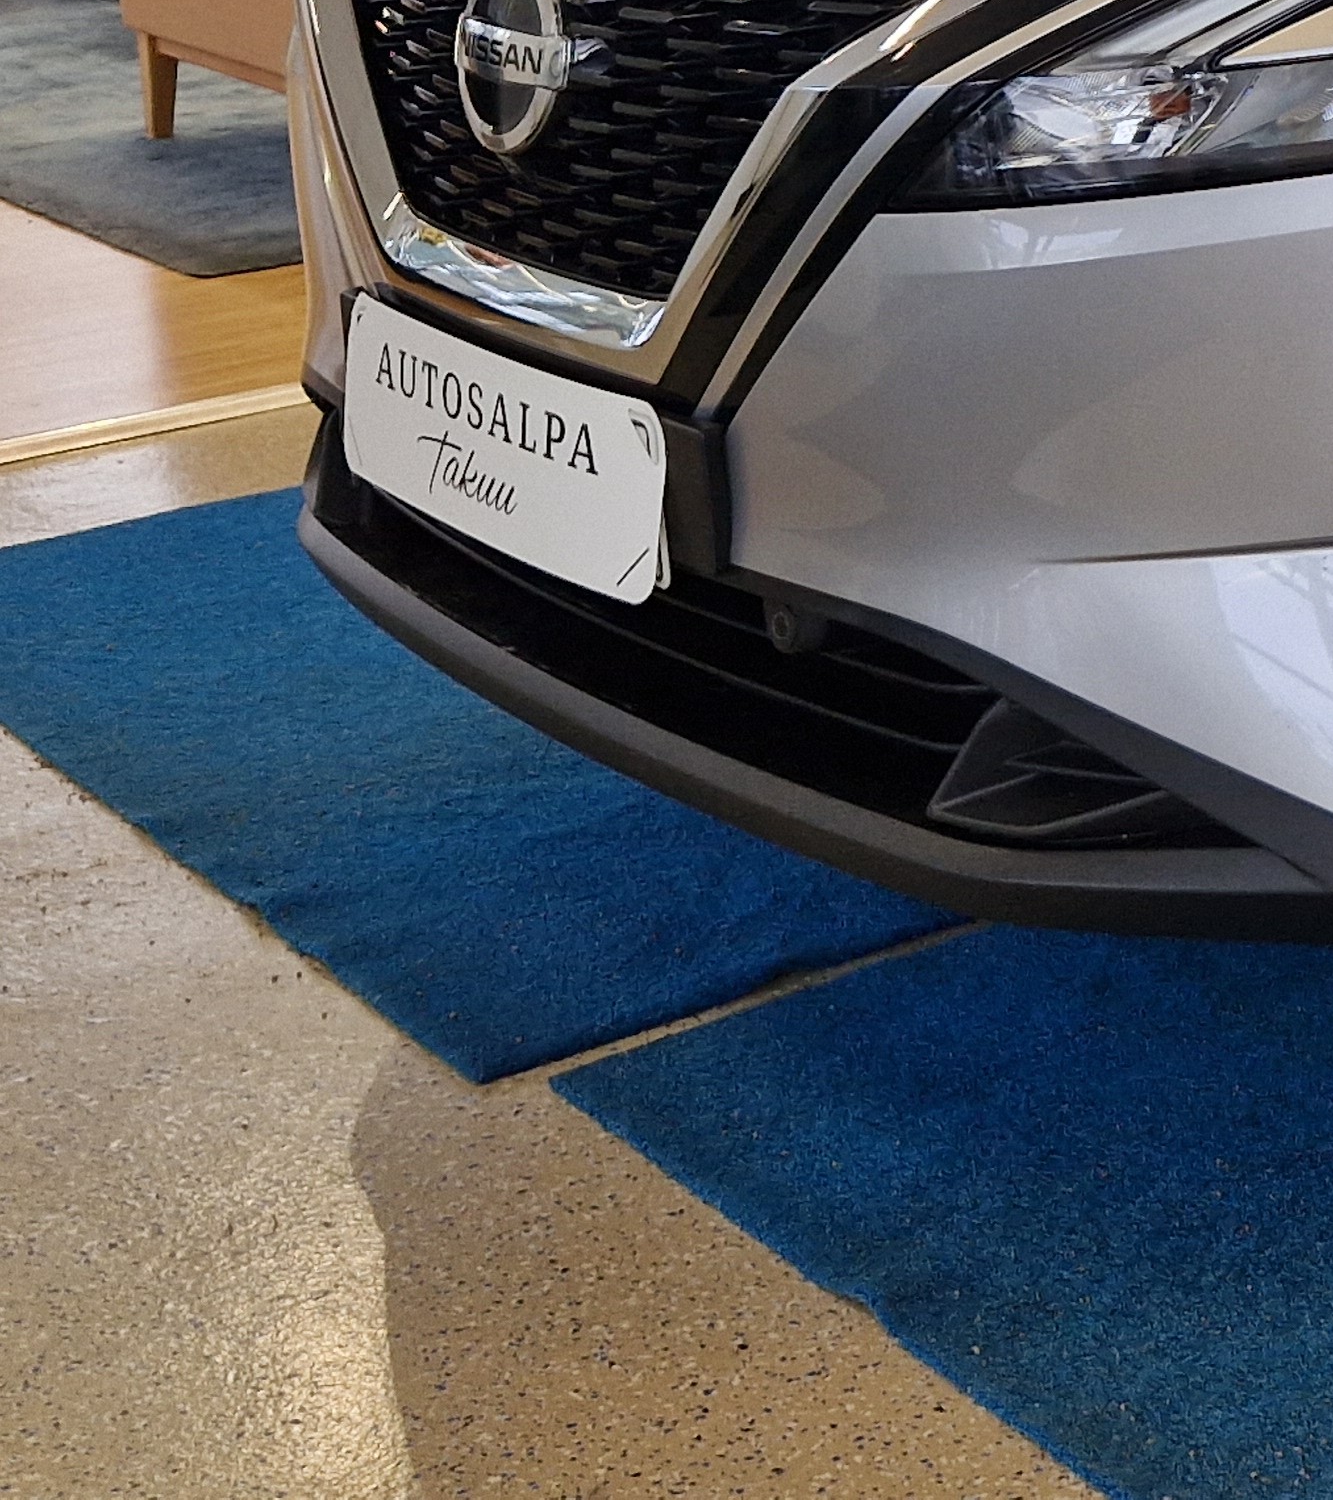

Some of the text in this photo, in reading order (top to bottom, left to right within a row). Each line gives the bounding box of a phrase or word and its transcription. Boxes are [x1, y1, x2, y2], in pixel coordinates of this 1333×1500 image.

[463, 31, 544, 75] NISSAN
[375, 342, 599, 476] AUTOSALPA
[417, 430, 518, 515] Takuu
